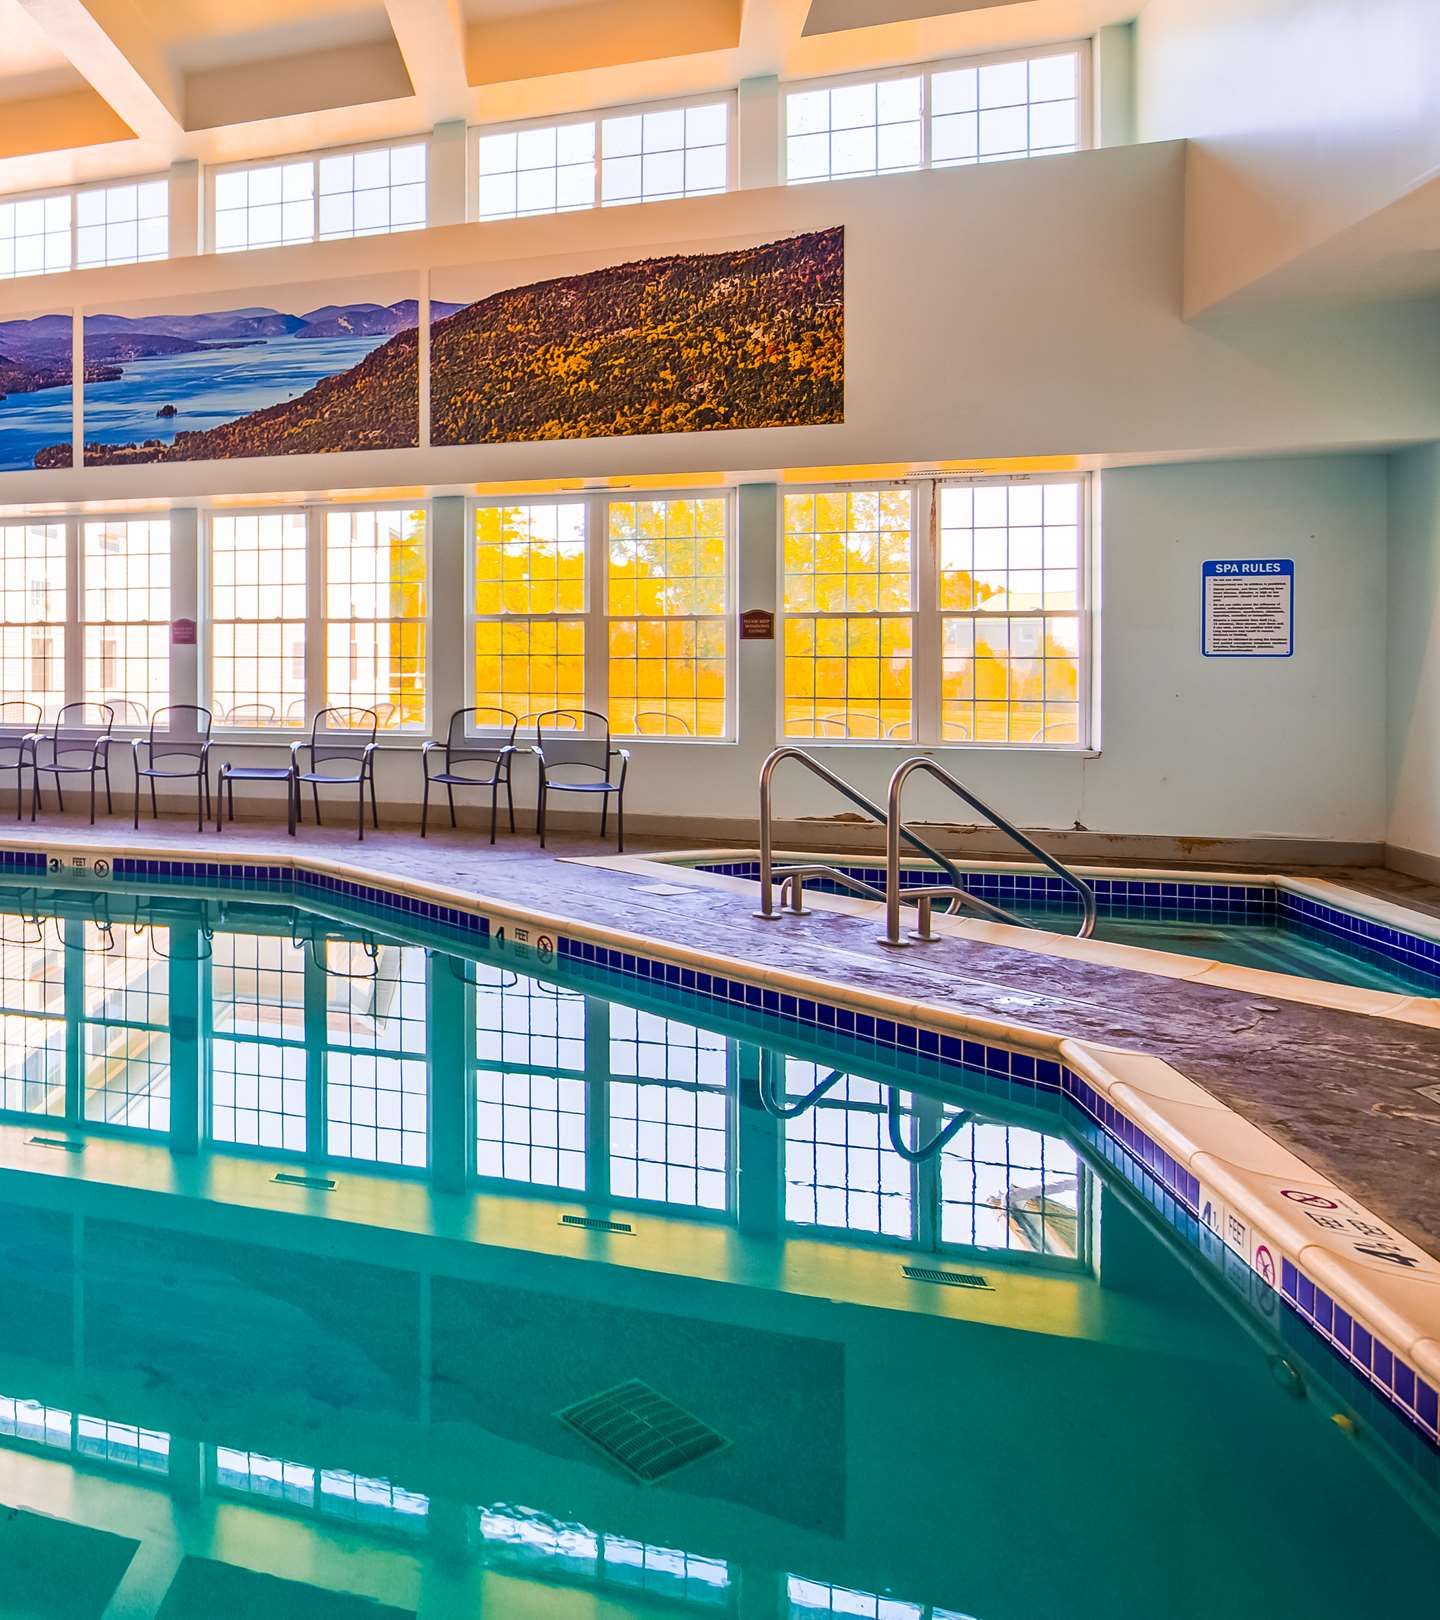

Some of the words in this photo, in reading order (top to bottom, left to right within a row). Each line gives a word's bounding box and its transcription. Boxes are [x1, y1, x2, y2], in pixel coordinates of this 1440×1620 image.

[1215, 564, 1239, 574] SPA
[1241, 563, 1281, 573] RULES
[72, 857, 86, 866] FEET
[1229, 1215, 1246, 1249] FEET
